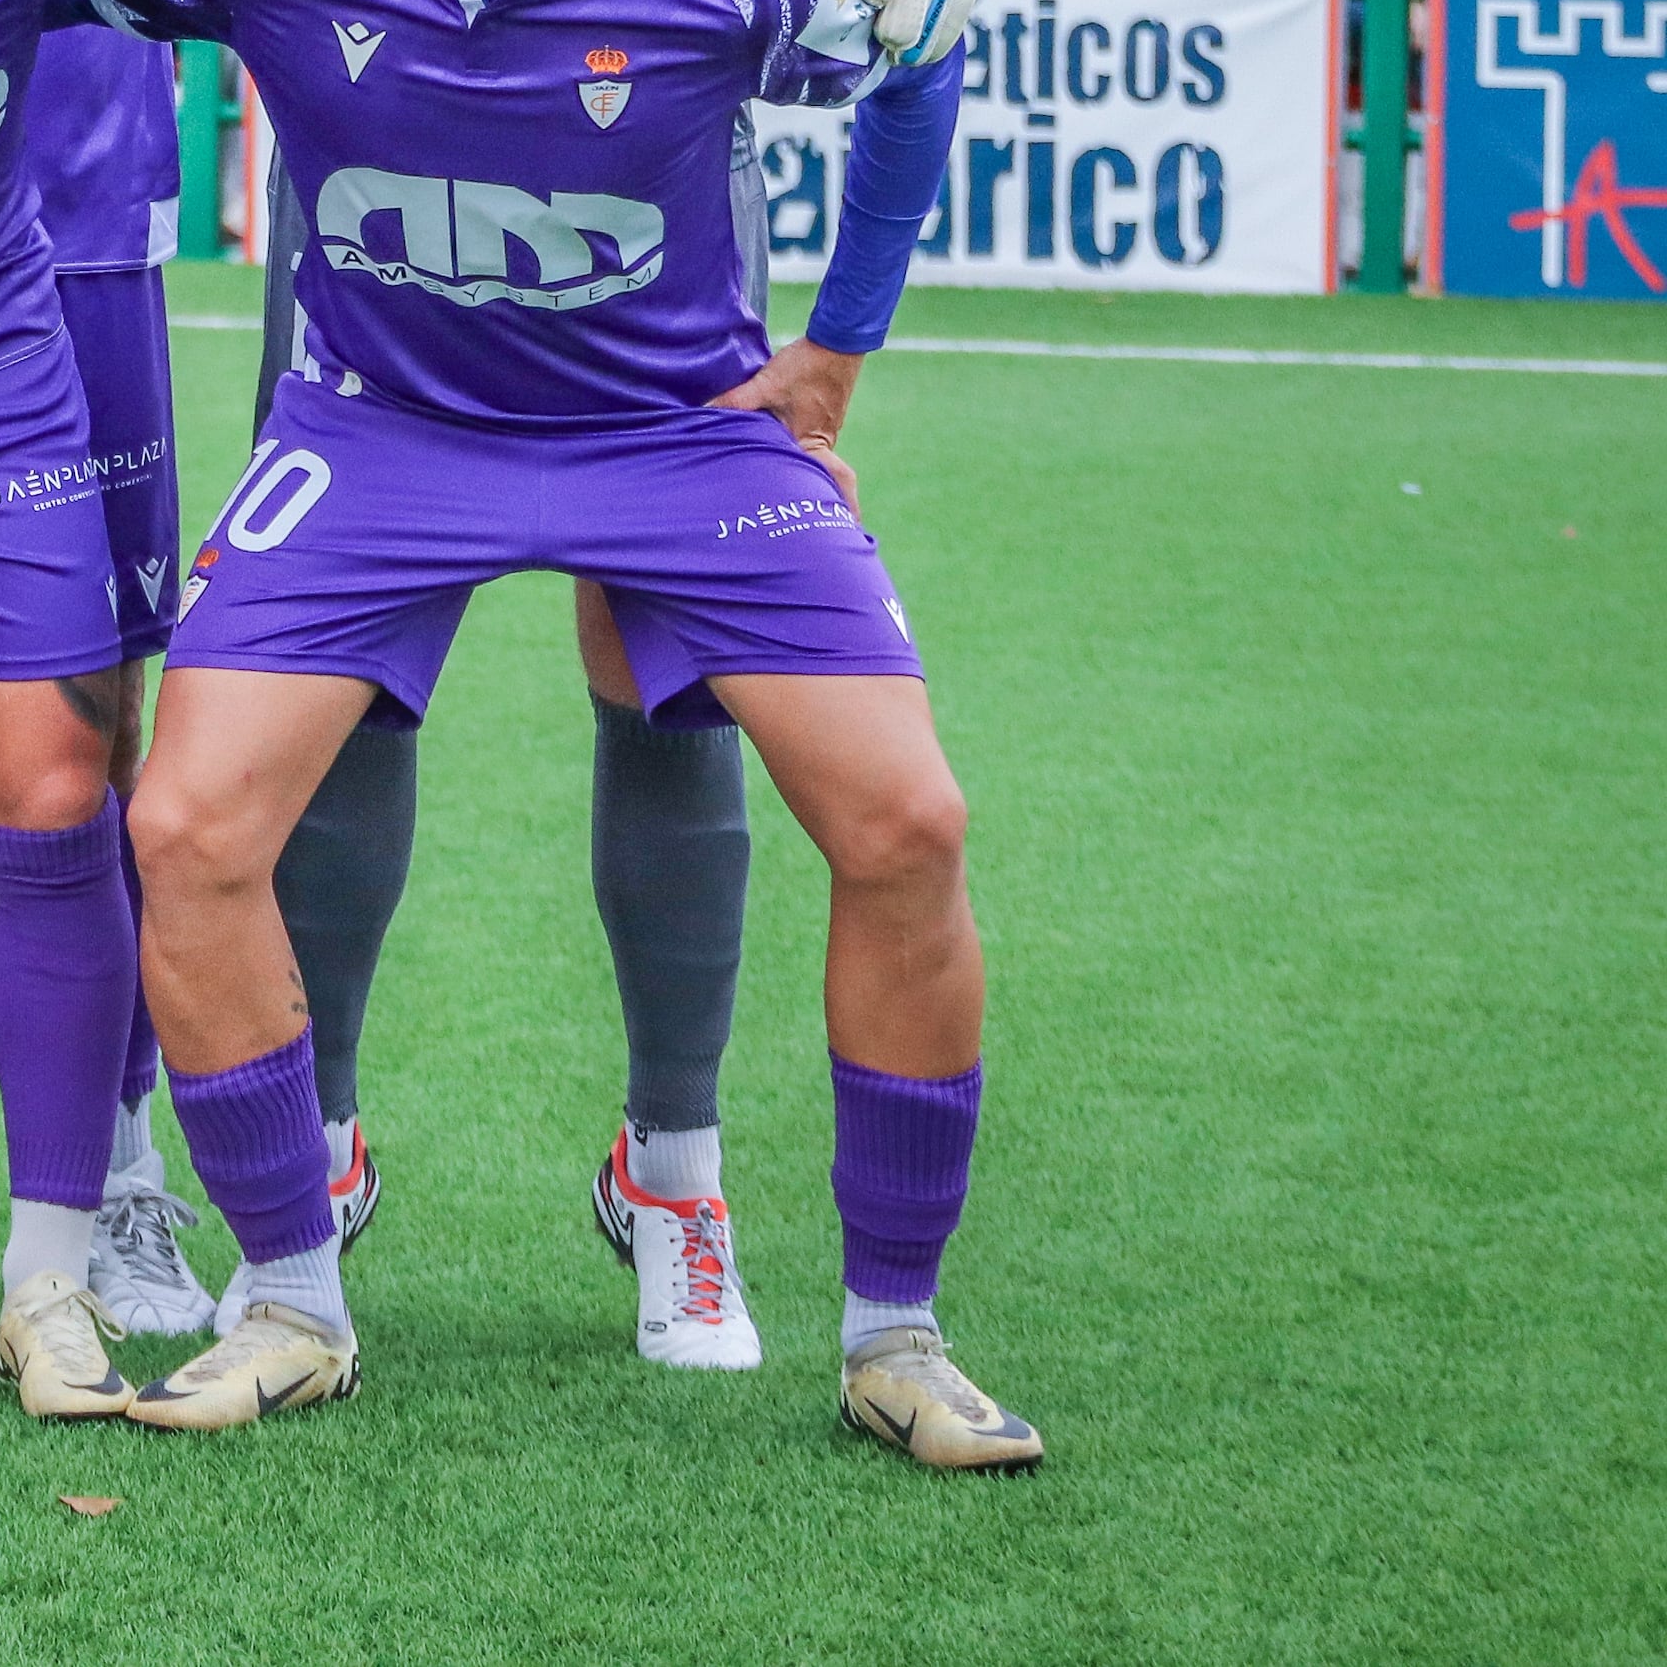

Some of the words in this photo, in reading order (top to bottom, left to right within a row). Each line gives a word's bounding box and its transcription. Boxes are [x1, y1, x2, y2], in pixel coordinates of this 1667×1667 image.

[32, 496, 67, 512] CENTRO
[203, 439, 333, 553] 10
[767, 522, 811, 539] CENTRO
